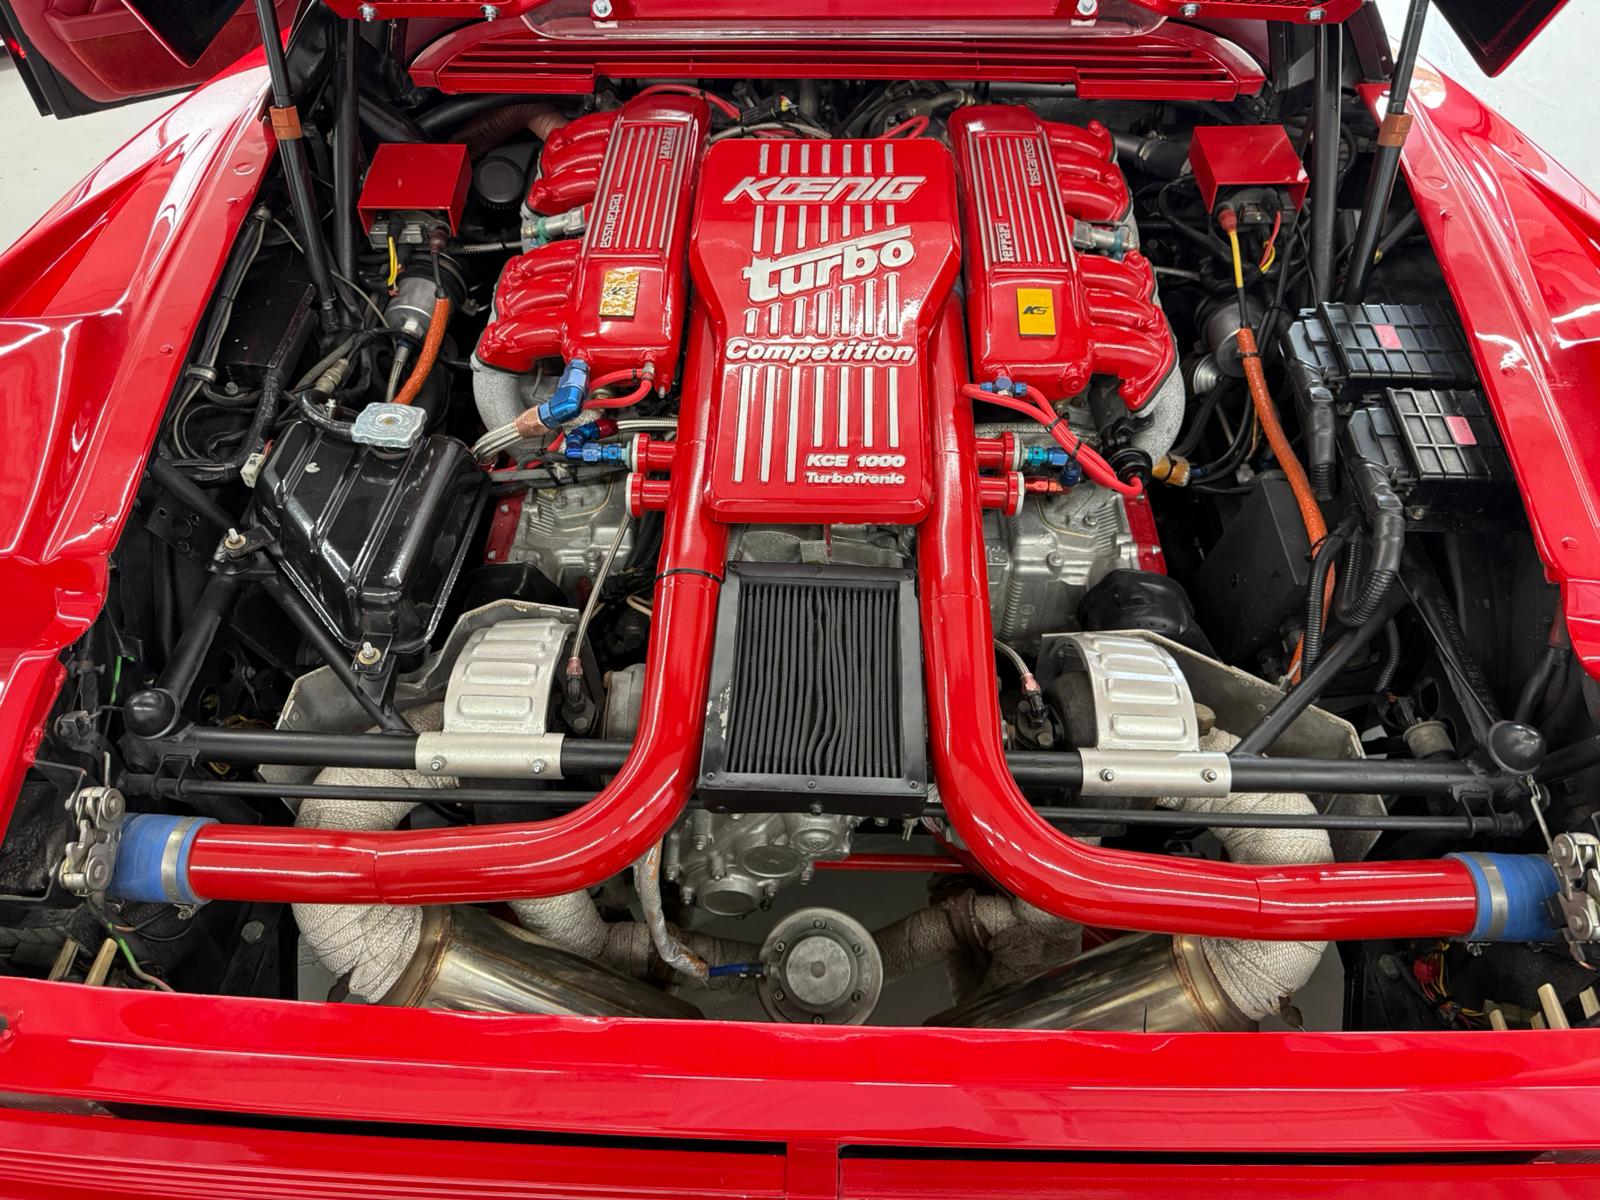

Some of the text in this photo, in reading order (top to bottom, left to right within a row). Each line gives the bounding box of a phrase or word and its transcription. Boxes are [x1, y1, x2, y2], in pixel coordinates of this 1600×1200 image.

[599, 193, 625, 248] testarossa
[742, 225, 915, 302] turbo
[726, 338, 915, 363] Competition
[806, 454, 906, 468] KCE 1000
[806, 471, 906, 485] TurboTronic
